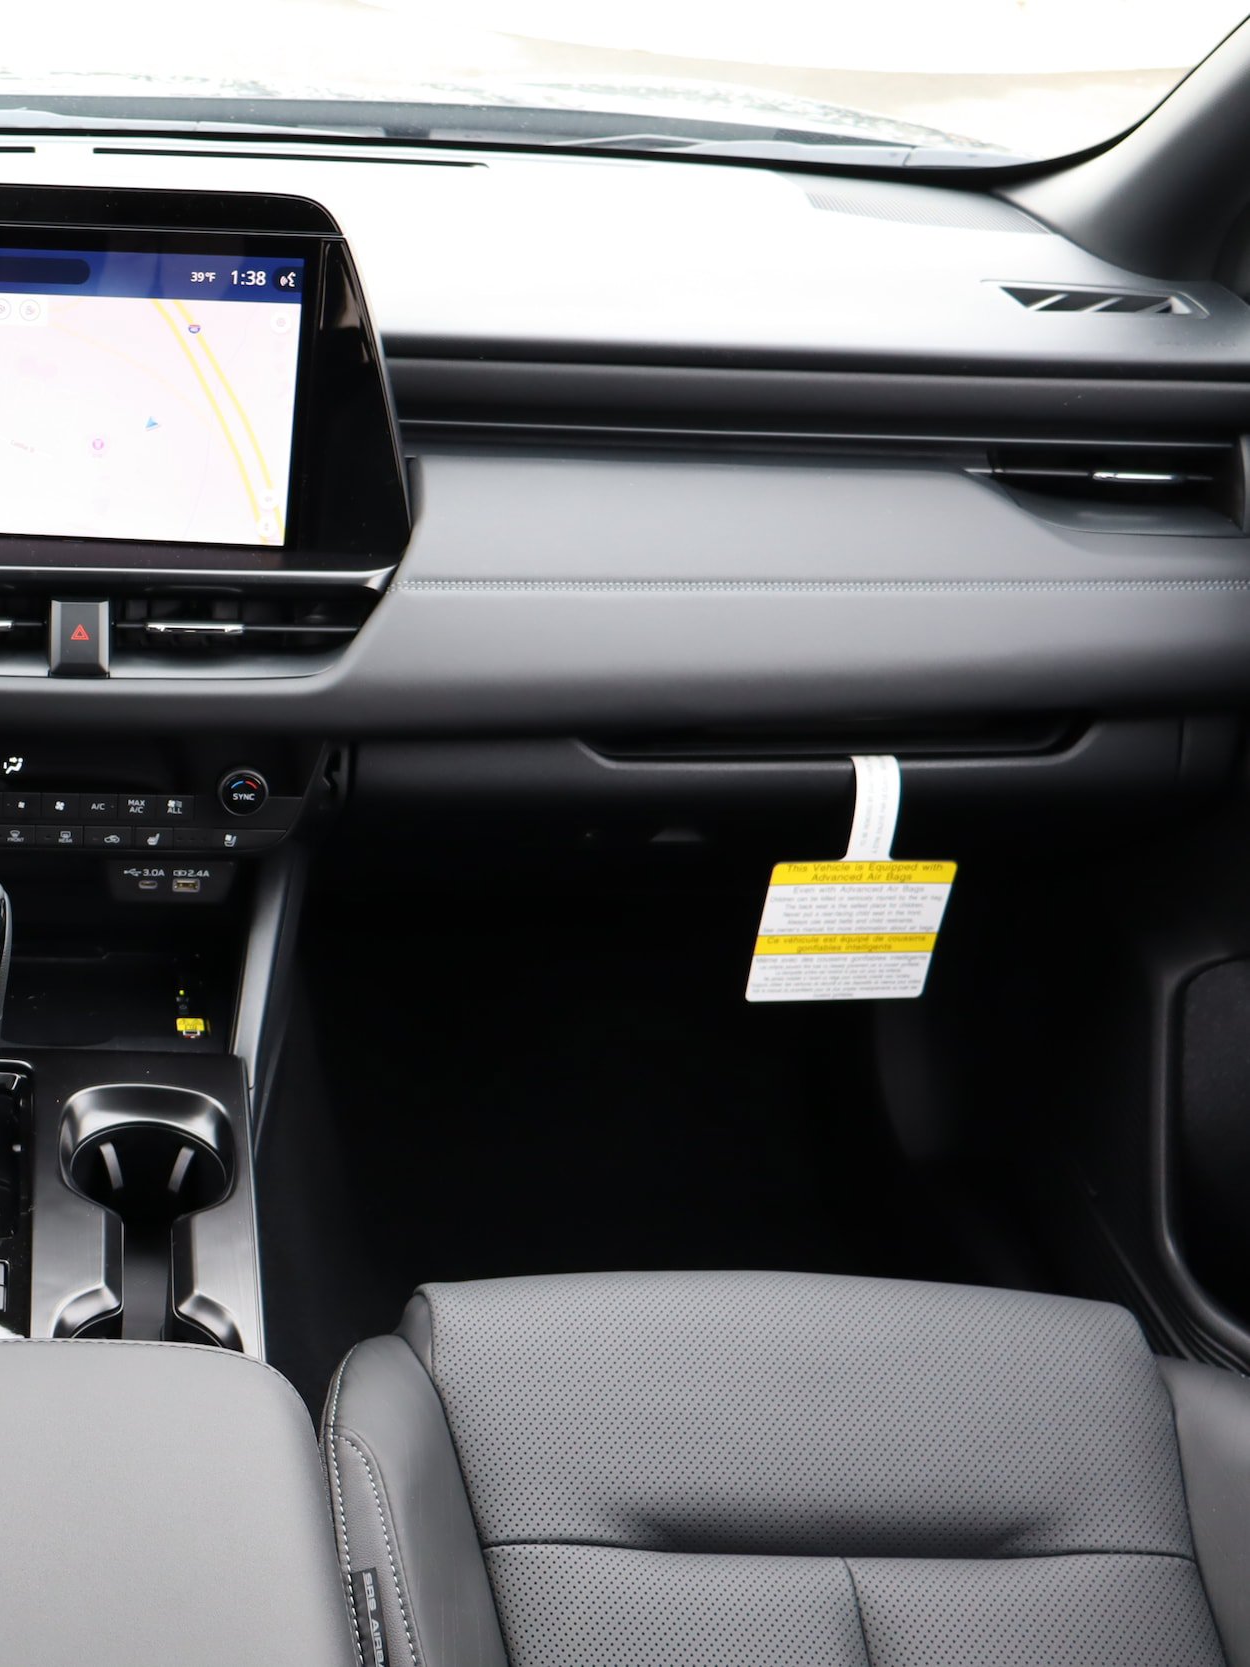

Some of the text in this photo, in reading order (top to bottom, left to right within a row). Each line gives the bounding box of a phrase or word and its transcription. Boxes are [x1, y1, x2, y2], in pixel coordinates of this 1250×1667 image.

[231, 270, 267, 286] 1:38
[232, 793, 255, 801] SYNC
[128, 799, 145, 807] MAX
[129, 806, 144, 814] A/C
[167, 807, 183, 815] ALL
[142, 869, 165, 877] 3.0A
[187, 869, 210, 878] 2.4A
[364, 1572, 385, 1667] SRS AIRB
